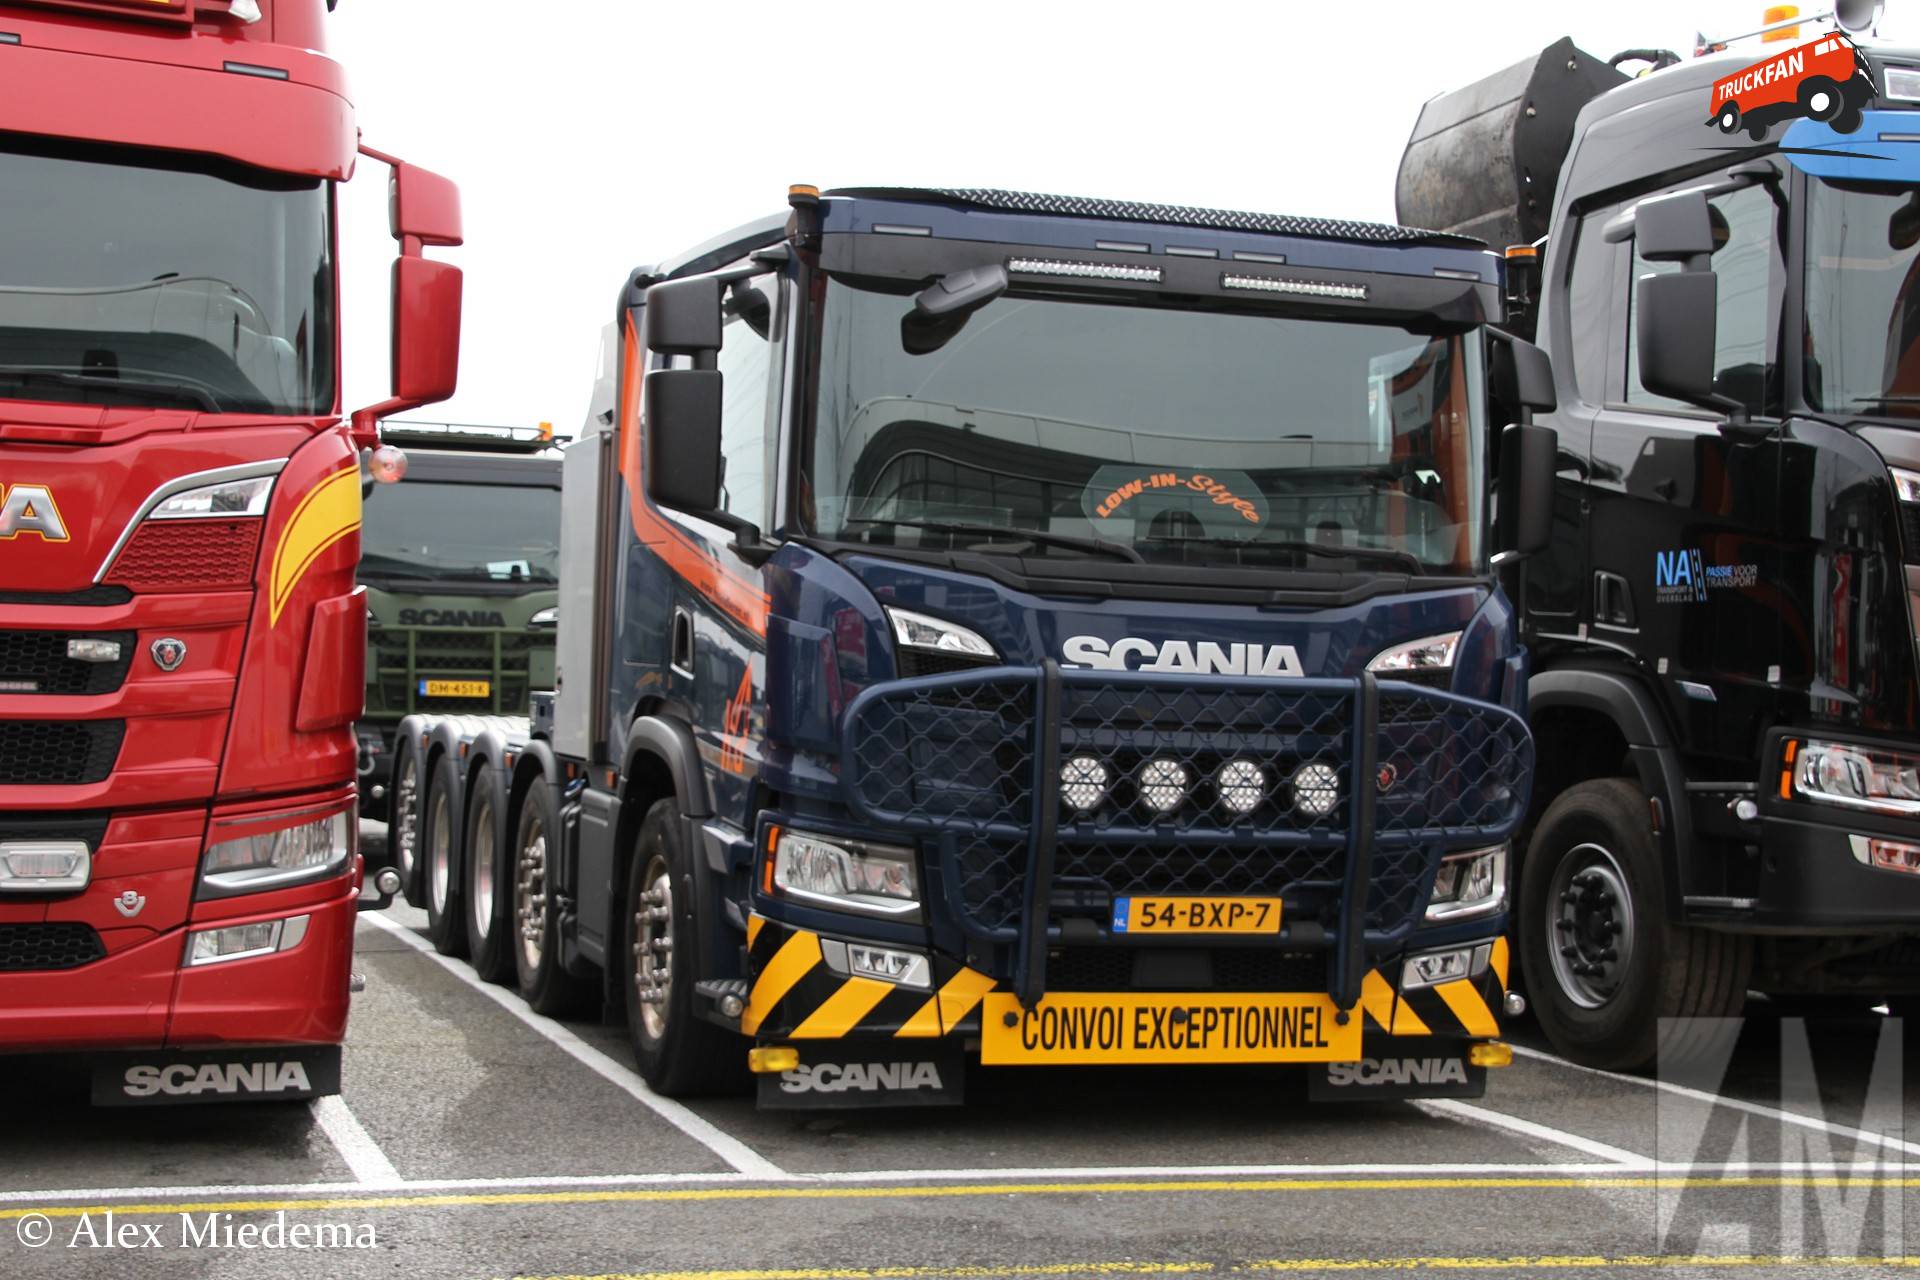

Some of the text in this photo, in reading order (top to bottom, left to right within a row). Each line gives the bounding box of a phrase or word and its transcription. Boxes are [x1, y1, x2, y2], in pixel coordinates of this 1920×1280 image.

[1656, 550, 1692, 586] NA
[398, 608, 506, 627] SCANIA
[1060, 635, 1305, 677] SCANIA
[1113, 918, 1126, 927] NL
[1140, 903, 1271, 928] 54-BXP-7
[1022, 1006, 1328, 1050] CONVOI EXCEPTIONNEL
[123, 1061, 312, 1096] SCANIA
[780, 1062, 943, 1093] SCANIA
[1327, 1057, 1468, 1086] SCANIA
